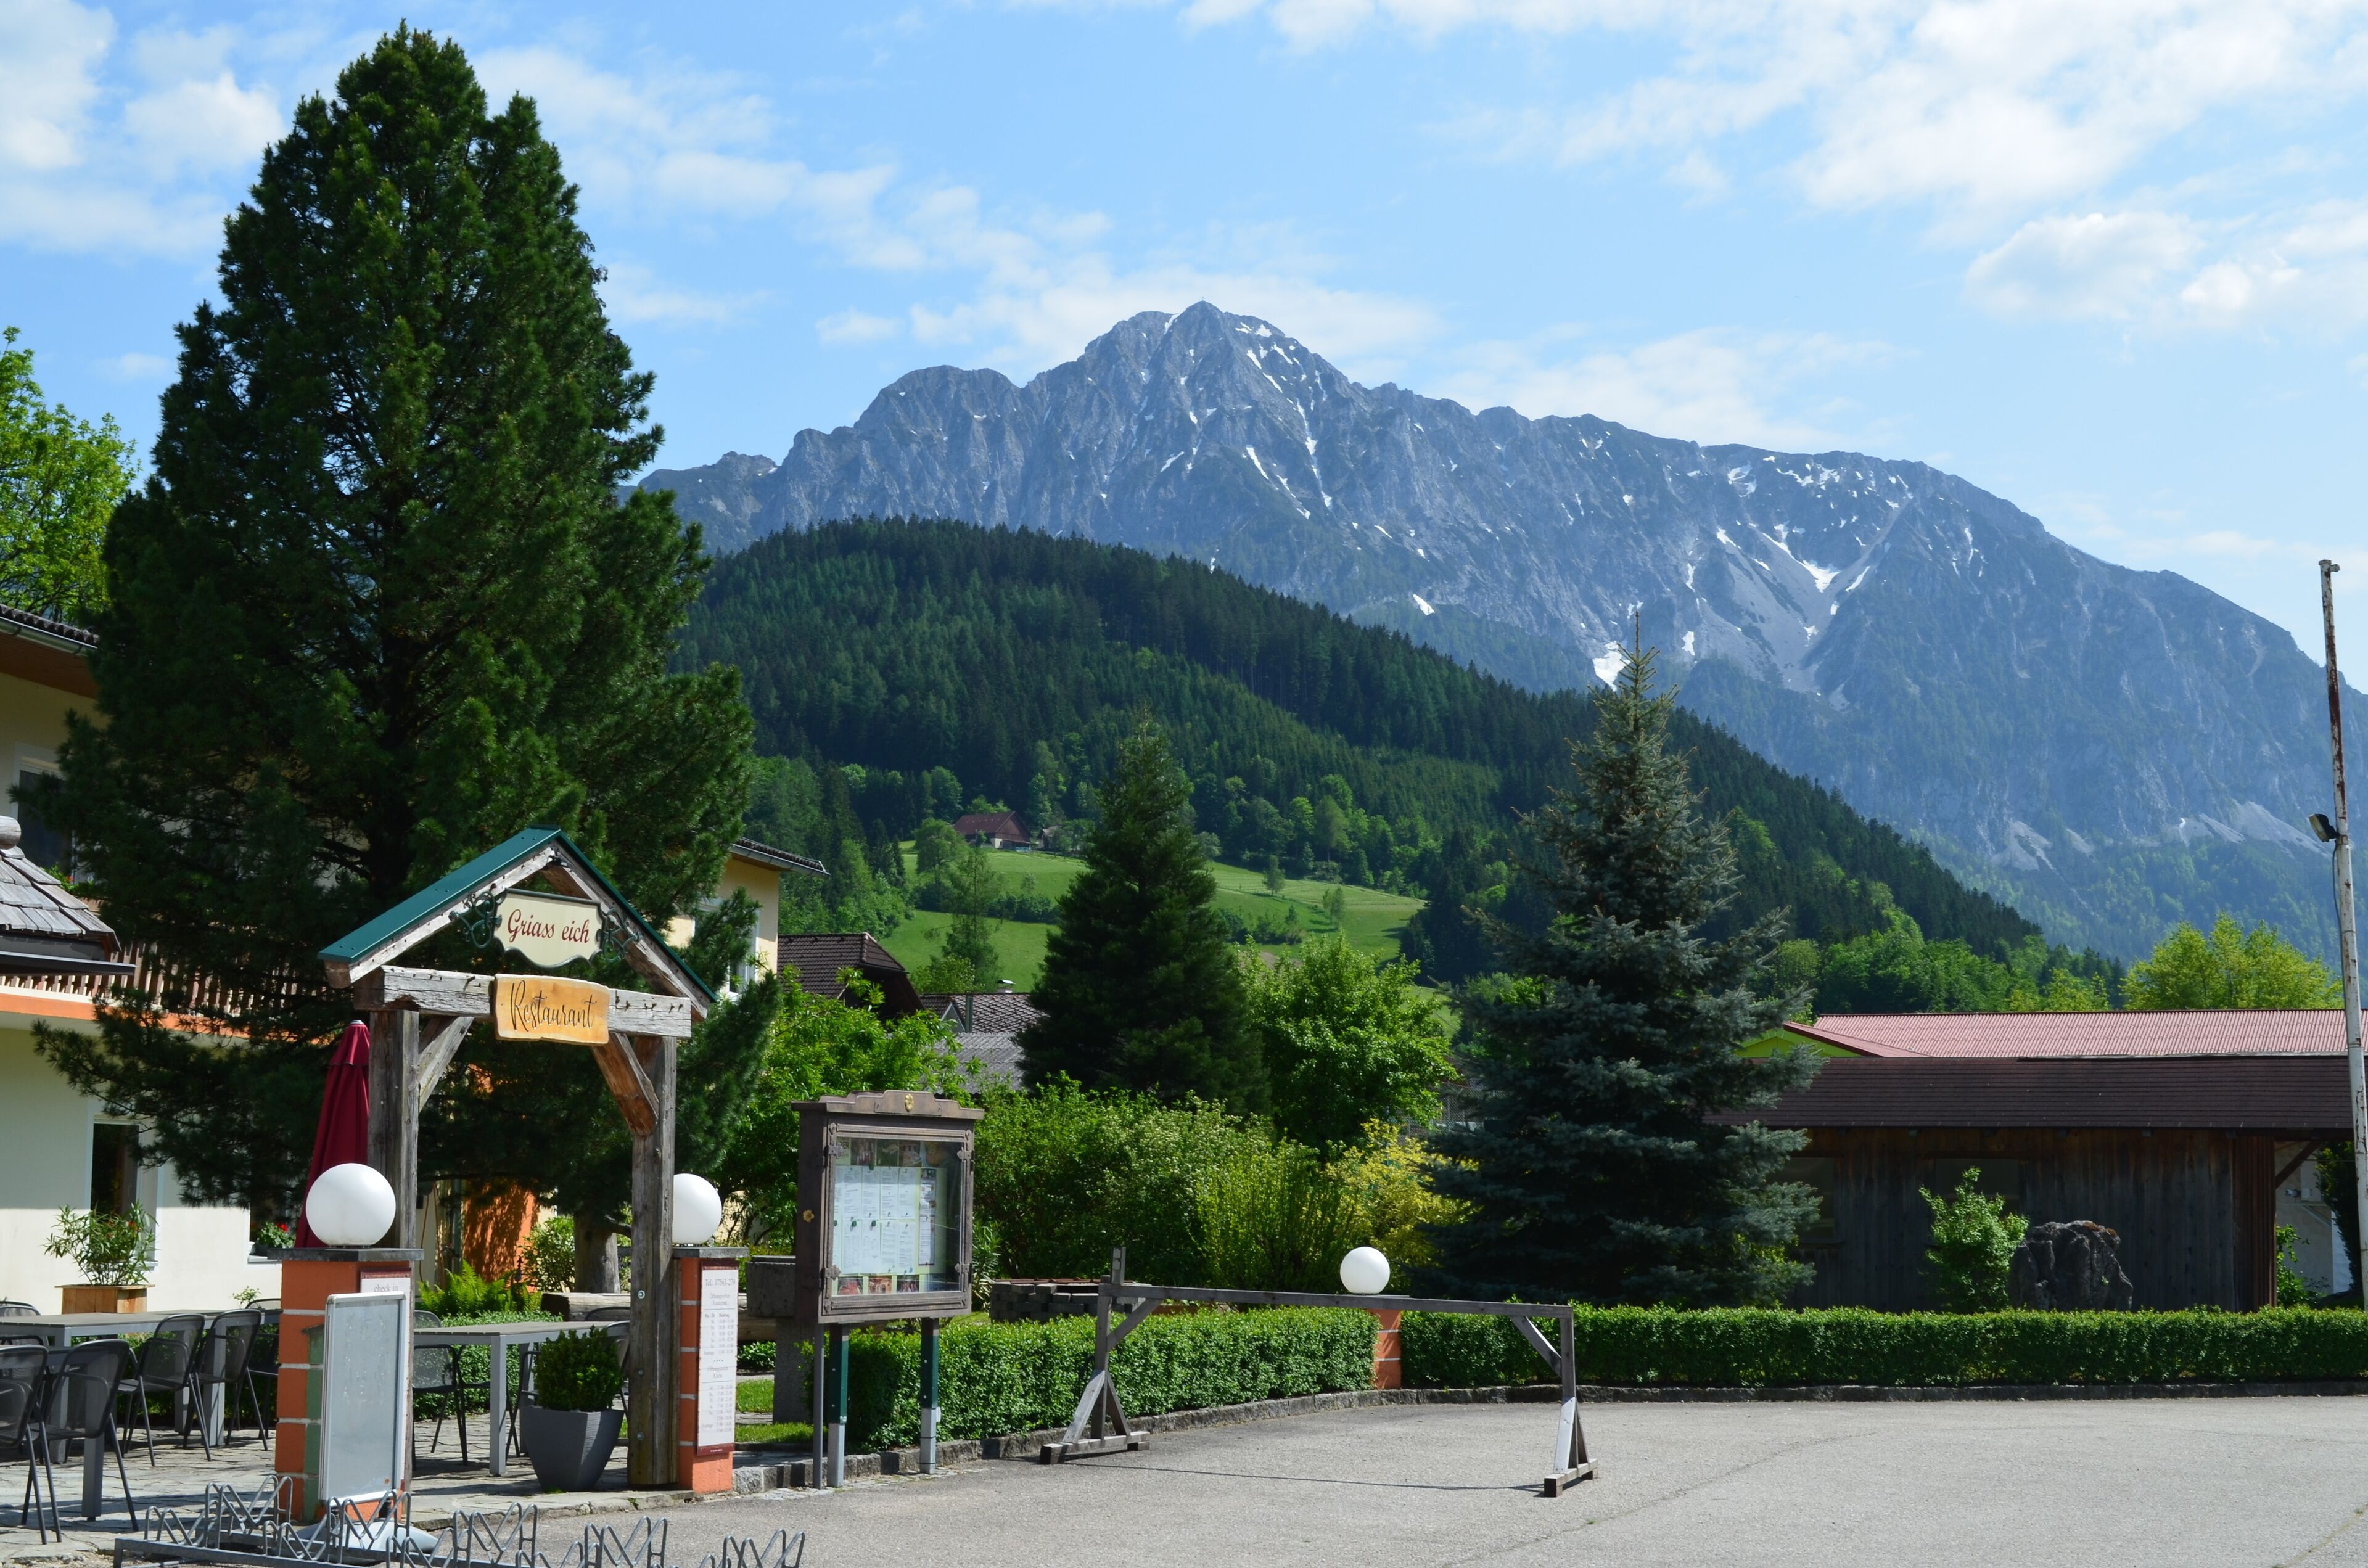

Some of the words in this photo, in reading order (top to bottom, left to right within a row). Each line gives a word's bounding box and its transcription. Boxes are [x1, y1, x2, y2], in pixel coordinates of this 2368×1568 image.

[508, 909, 555, 943] Griass
[561, 919, 590, 944] eich
[510, 980, 597, 1032] Restaurant
[374, 1283, 391, 1292] check
[392, 1283, 398, 1292] in
